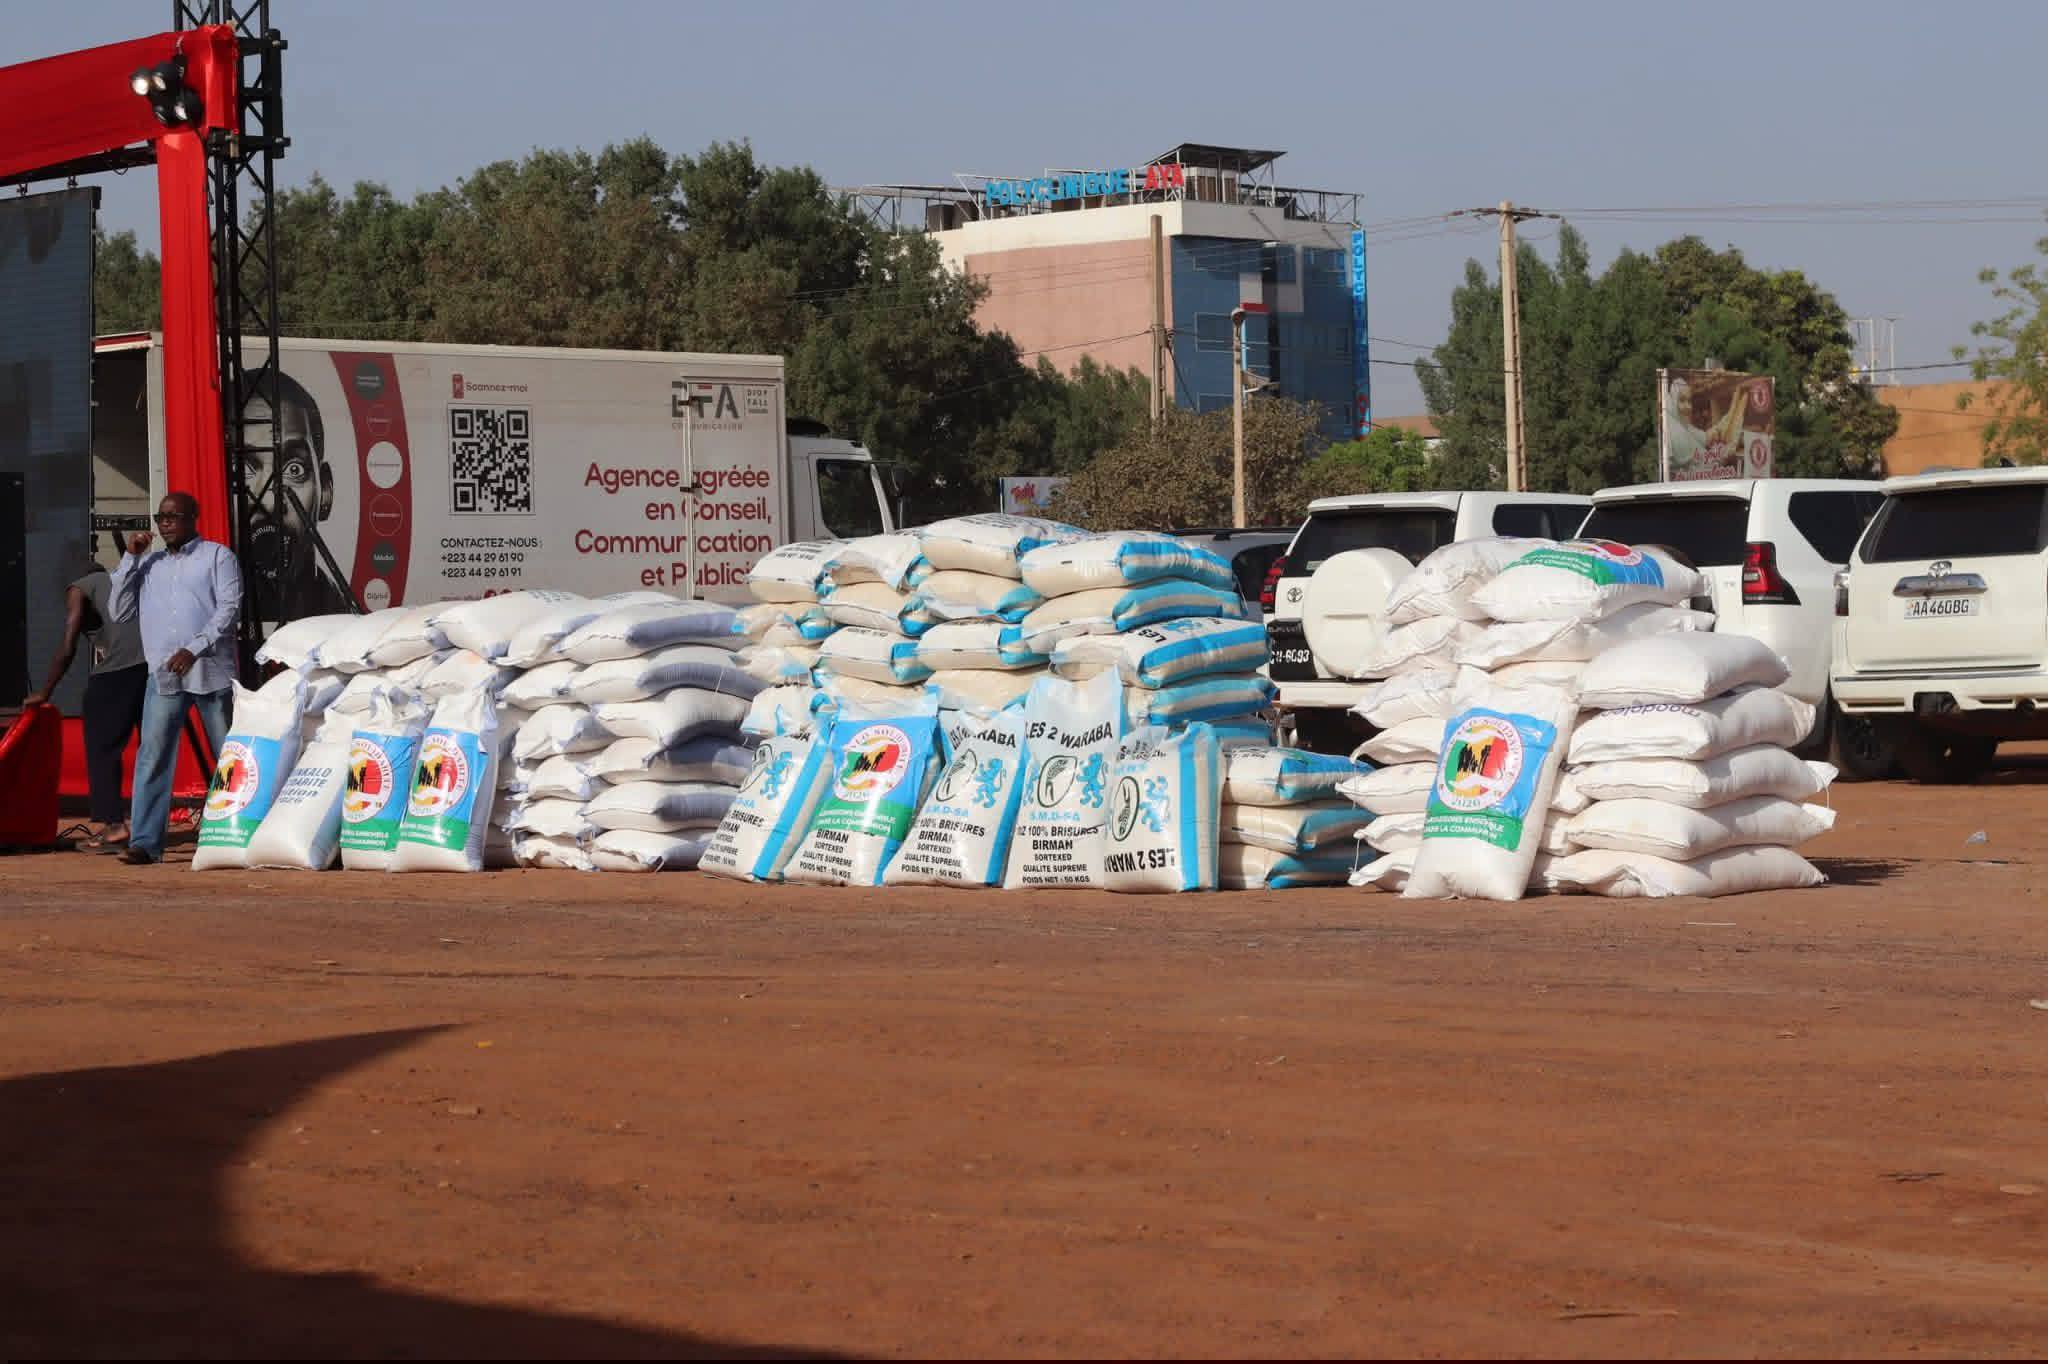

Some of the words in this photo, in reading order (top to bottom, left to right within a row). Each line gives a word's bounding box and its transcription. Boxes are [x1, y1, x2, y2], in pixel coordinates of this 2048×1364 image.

[985, 167, 1130, 208] POLYCLINIQUE
[1143, 162, 1185, 190] AYA
[585, 462, 680, 494] Agence
[645, 502, 675, 521] en
[441, 553, 466, 563] +223
[468, 553, 482, 562] 44
[484, 553, 497, 562] 29
[441, 567, 466, 578] +223
[468, 567, 482, 577] 44
[484, 567, 497, 577] 29
[641, 566, 665, 586] et
[1025, 721, 1046, 740] LES
[1047, 726, 1058, 740] 2
[1060, 721, 1113, 749] WARABA
[816, 828, 849, 843] BIRMAN
[939, 819, 985, 837] BRISURES
[1032, 839, 1073, 850] BIRMAN
[1022, 864, 1051, 872] QUALITE
[1053, 864, 1088, 872] SUPREME
[1137, 850, 1146, 870] 2
